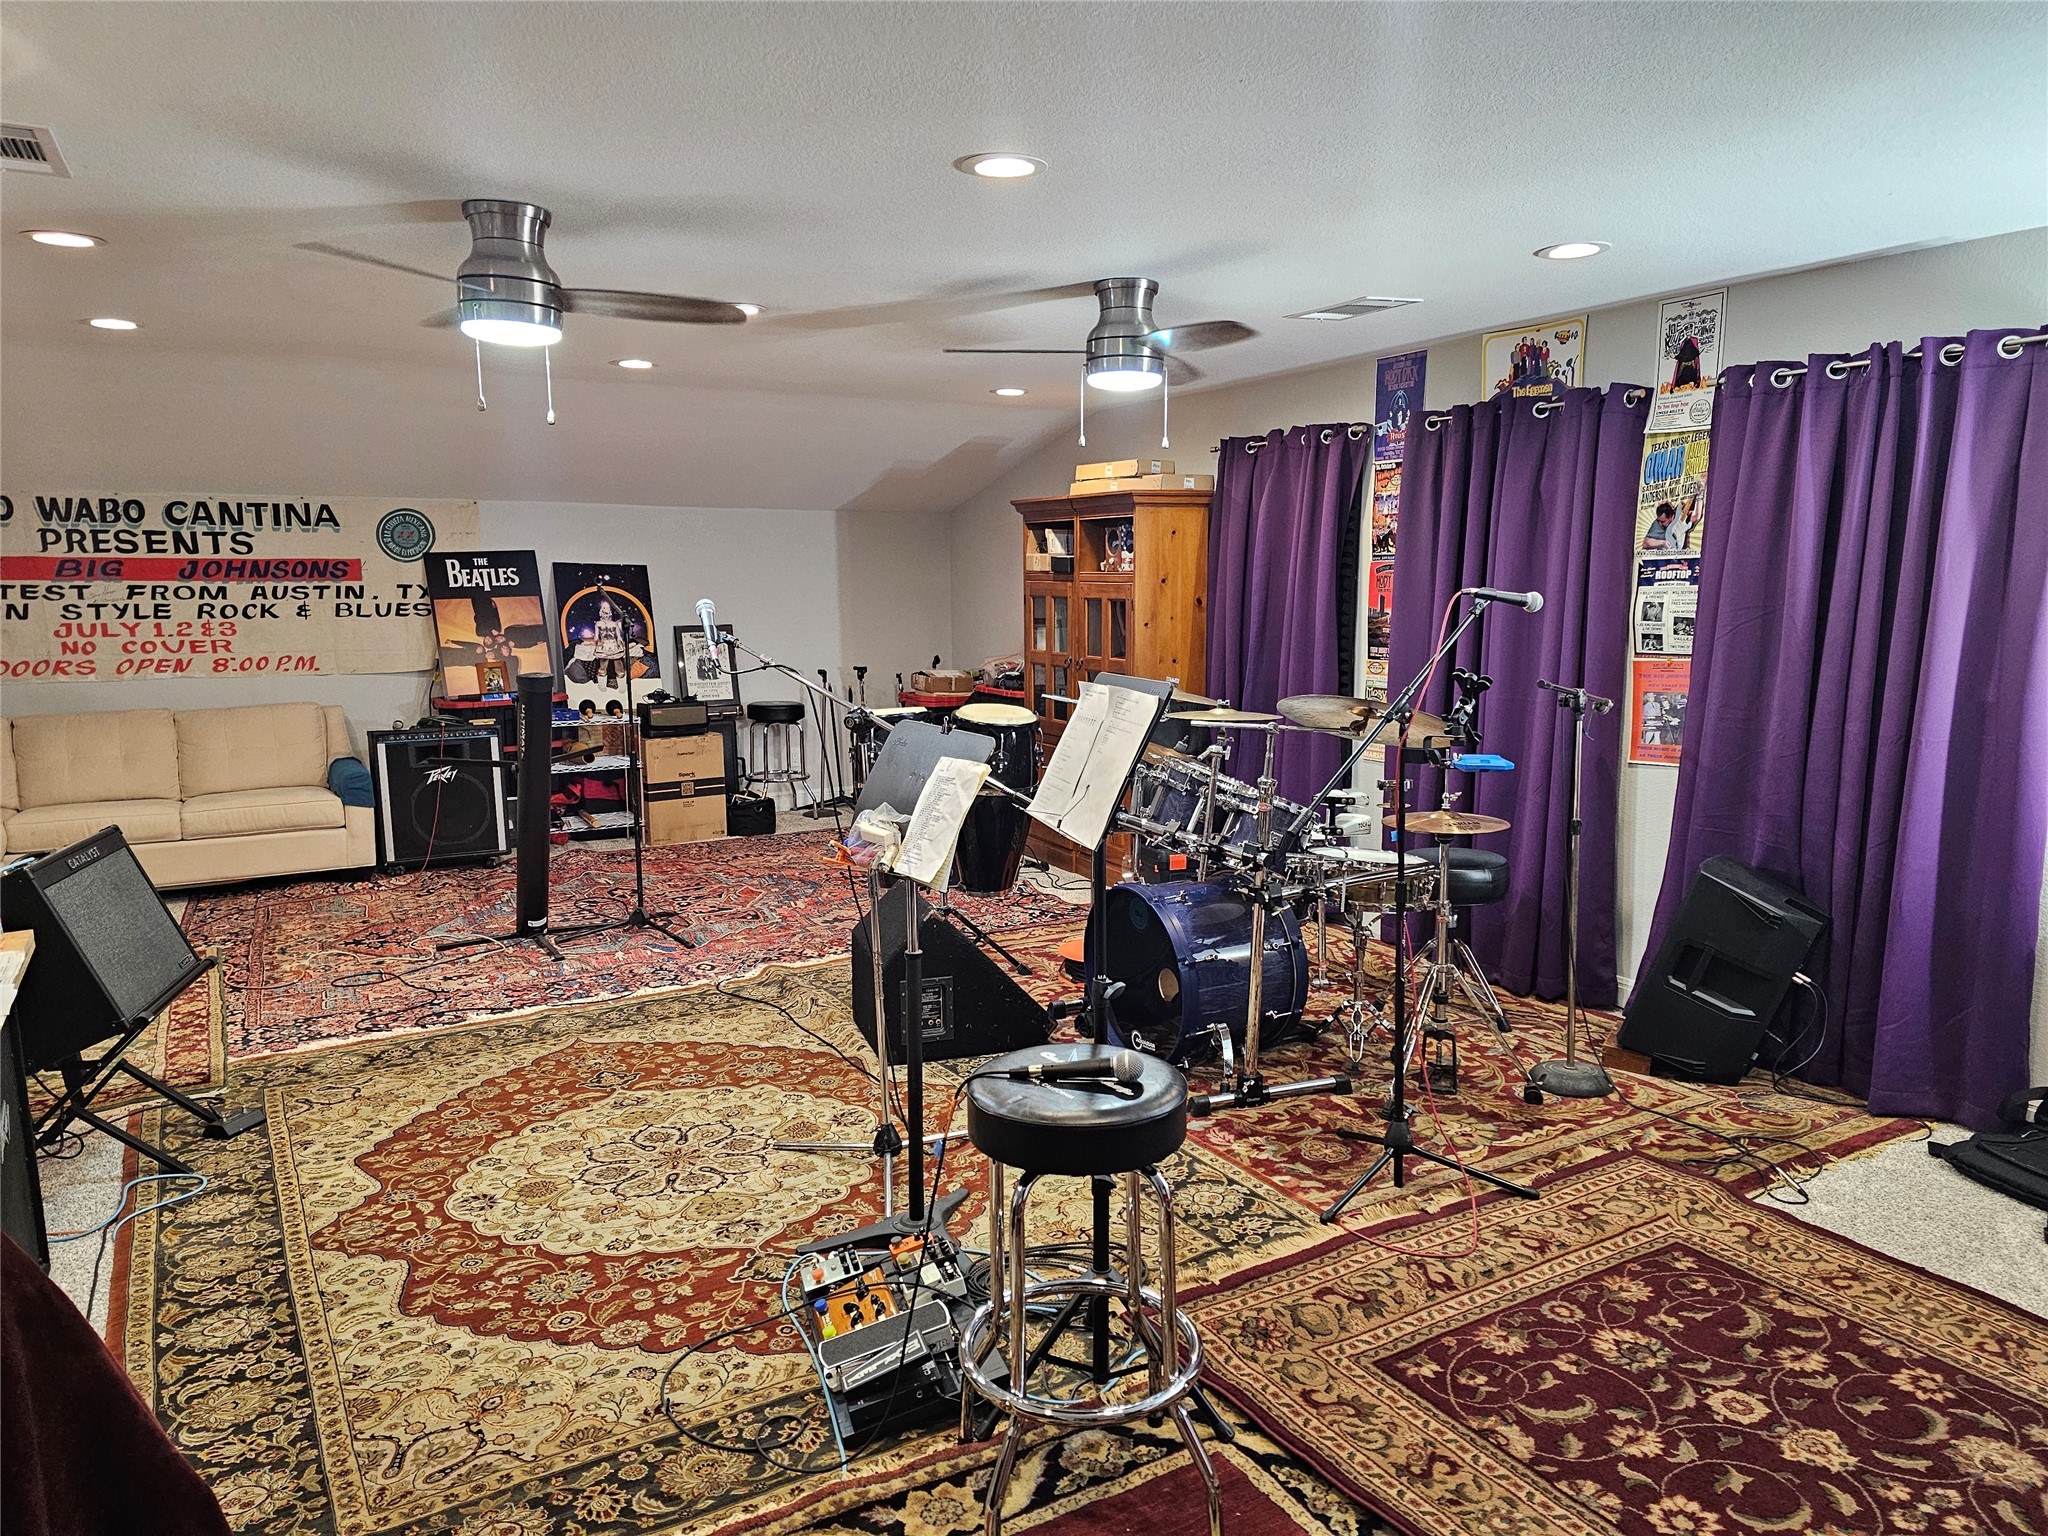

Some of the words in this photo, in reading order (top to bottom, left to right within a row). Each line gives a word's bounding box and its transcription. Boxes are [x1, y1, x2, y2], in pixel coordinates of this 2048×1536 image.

[1511, 386, 1526, 398] The
[1651, 440, 1670, 452] TEXAS
[1671, 435, 1690, 448] MUSIC
[1644, 446, 1686, 485] OMAR
[1641, 488, 1668, 504] ANDERSON
[1681, 480, 1701, 496] TAVERN
[35, 496, 146, 524] WABO
[164, 500, 341, 528] CANTINA
[37, 528, 255, 555] PRESENTS
[54, 559, 124, 578] BIG
[178, 560, 350, 580] JOHNSONS
[472, 557, 489, 566] THE
[445, 559, 520, 592] BEATLES
[1655, 569, 1692, 580] ROOFTOP
[126, 584, 228, 600] FROM
[396, 584, 430, 600] TX
[60, 603, 172, 621] STYLE
[197, 602, 280, 620] ROCK
[296, 601, 312, 621] &
[335, 602, 432, 618] BLUES
[53, 622, 142, 638] JULY
[61, 640, 97, 656] NO
[121, 639, 235, 654] COVER
[116, 657, 195, 675] OPEN
[67, 846, 101, 869] CATALYST
